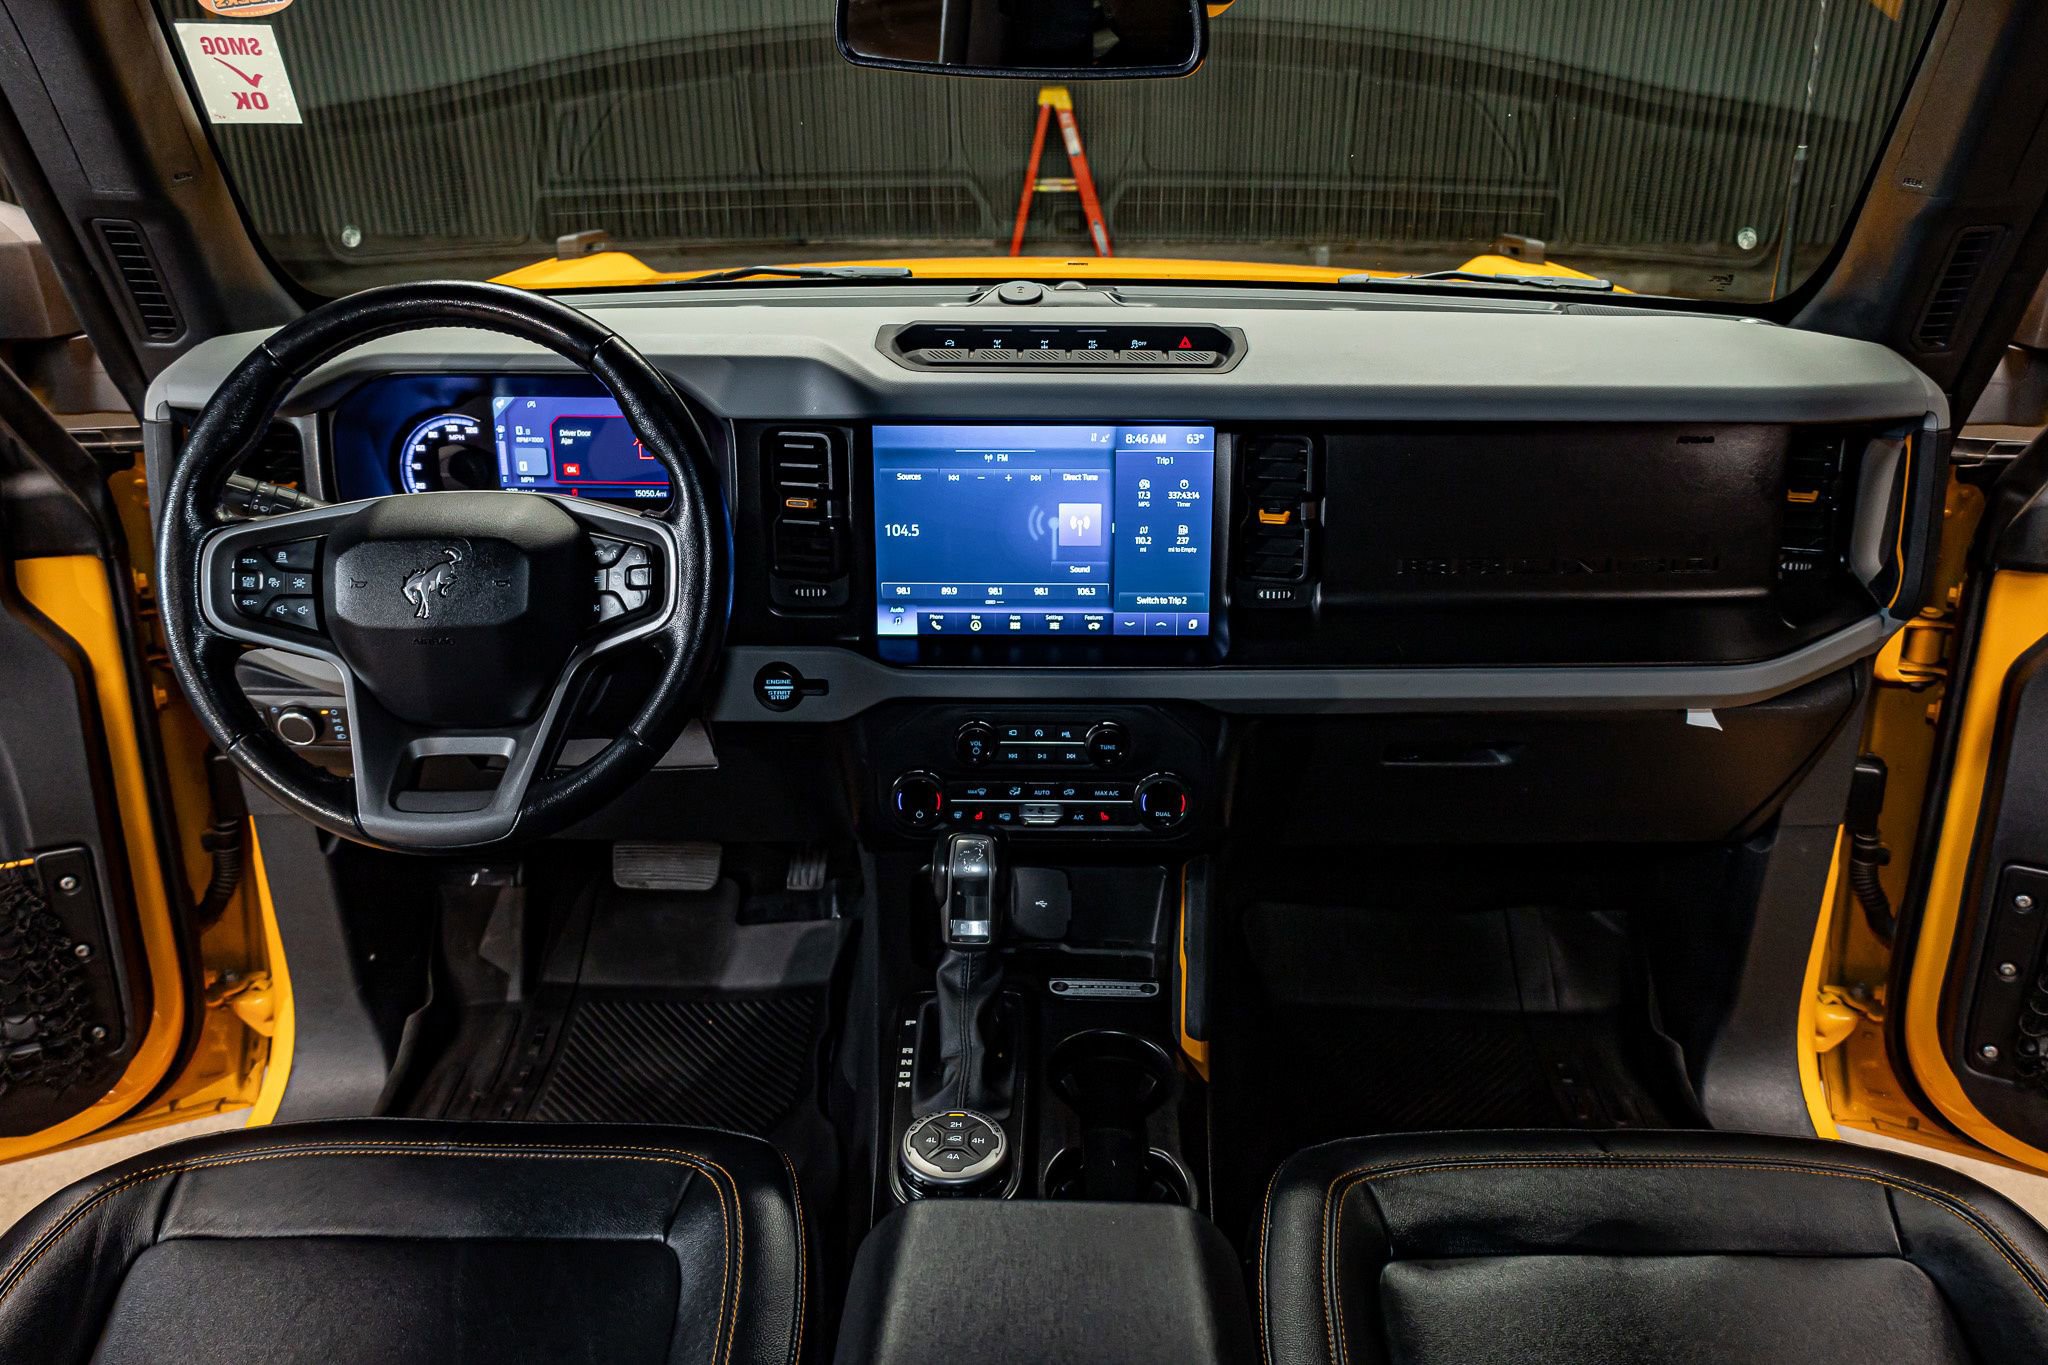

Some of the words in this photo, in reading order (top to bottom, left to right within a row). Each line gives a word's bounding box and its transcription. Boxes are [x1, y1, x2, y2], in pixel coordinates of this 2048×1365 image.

[1125, 434, 1149, 444] 8:46
[1150, 434, 1167, 444] AM
[1156, 457, 1170, 465] Trip
[884, 524, 920, 537] 104.5
[1176, 537, 1189, 545] 237
[896, 587, 911, 595] 98.1
[987, 587, 1003, 595] 98.1
[1033, 587, 1049, 596] 98.1
[1136, 596, 1159, 605] Switch
[1159, 597, 1167, 605] to
[1168, 597, 1182, 606] Trip
